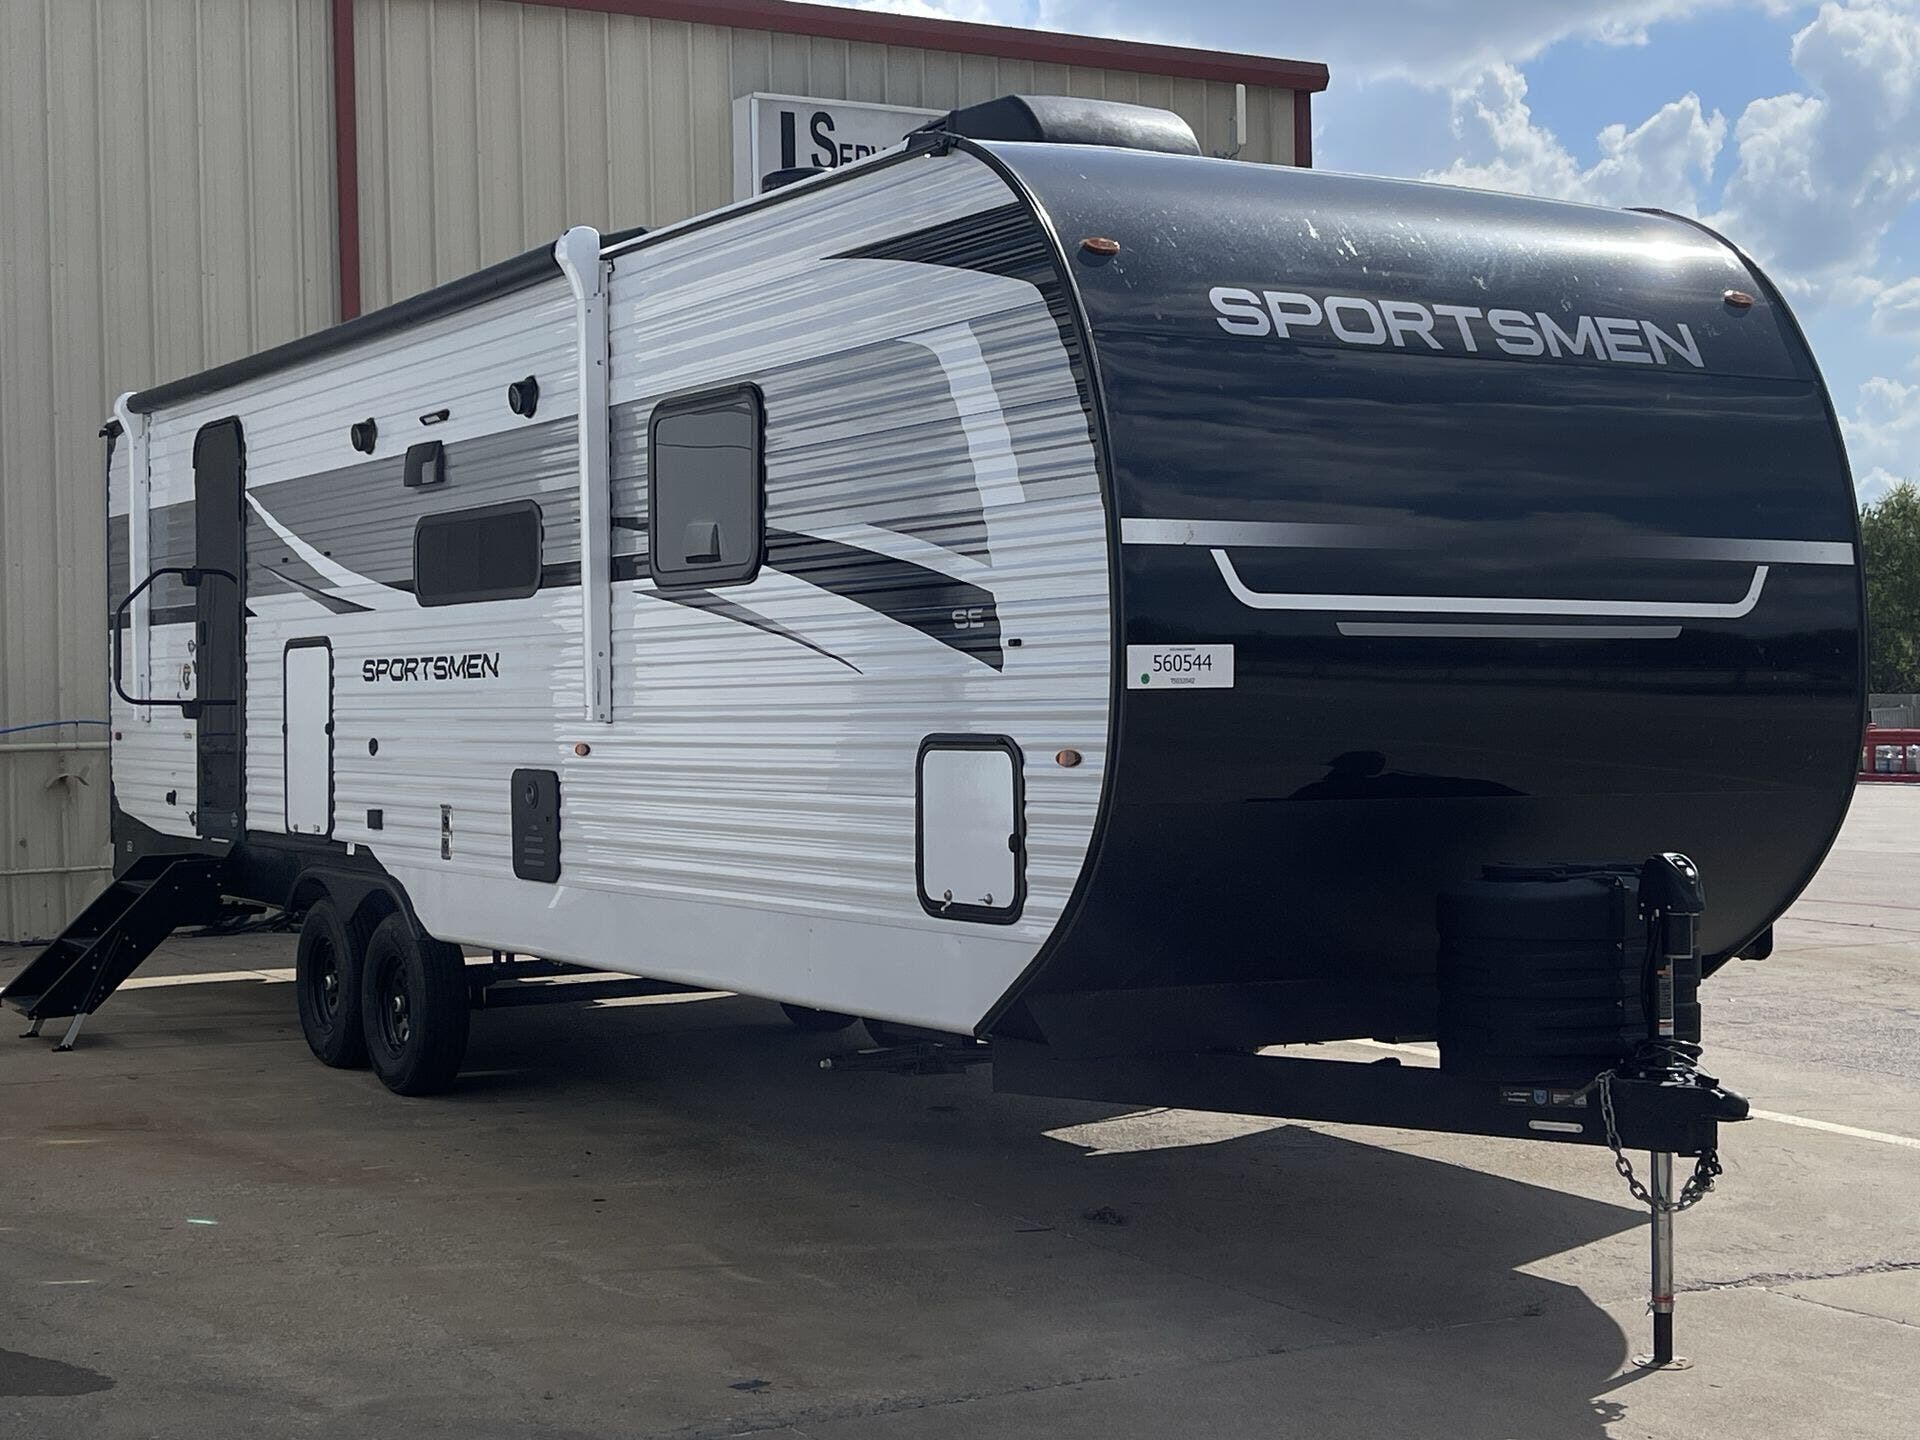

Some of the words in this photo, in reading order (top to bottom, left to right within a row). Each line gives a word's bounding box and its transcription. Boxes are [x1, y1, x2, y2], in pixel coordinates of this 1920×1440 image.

[1208, 286, 1705, 368] SPORTSMEN
[951, 607, 985, 630] SE
[362, 652, 500, 682] SPORTSMEN
[1152, 654, 1213, 672] 560544
